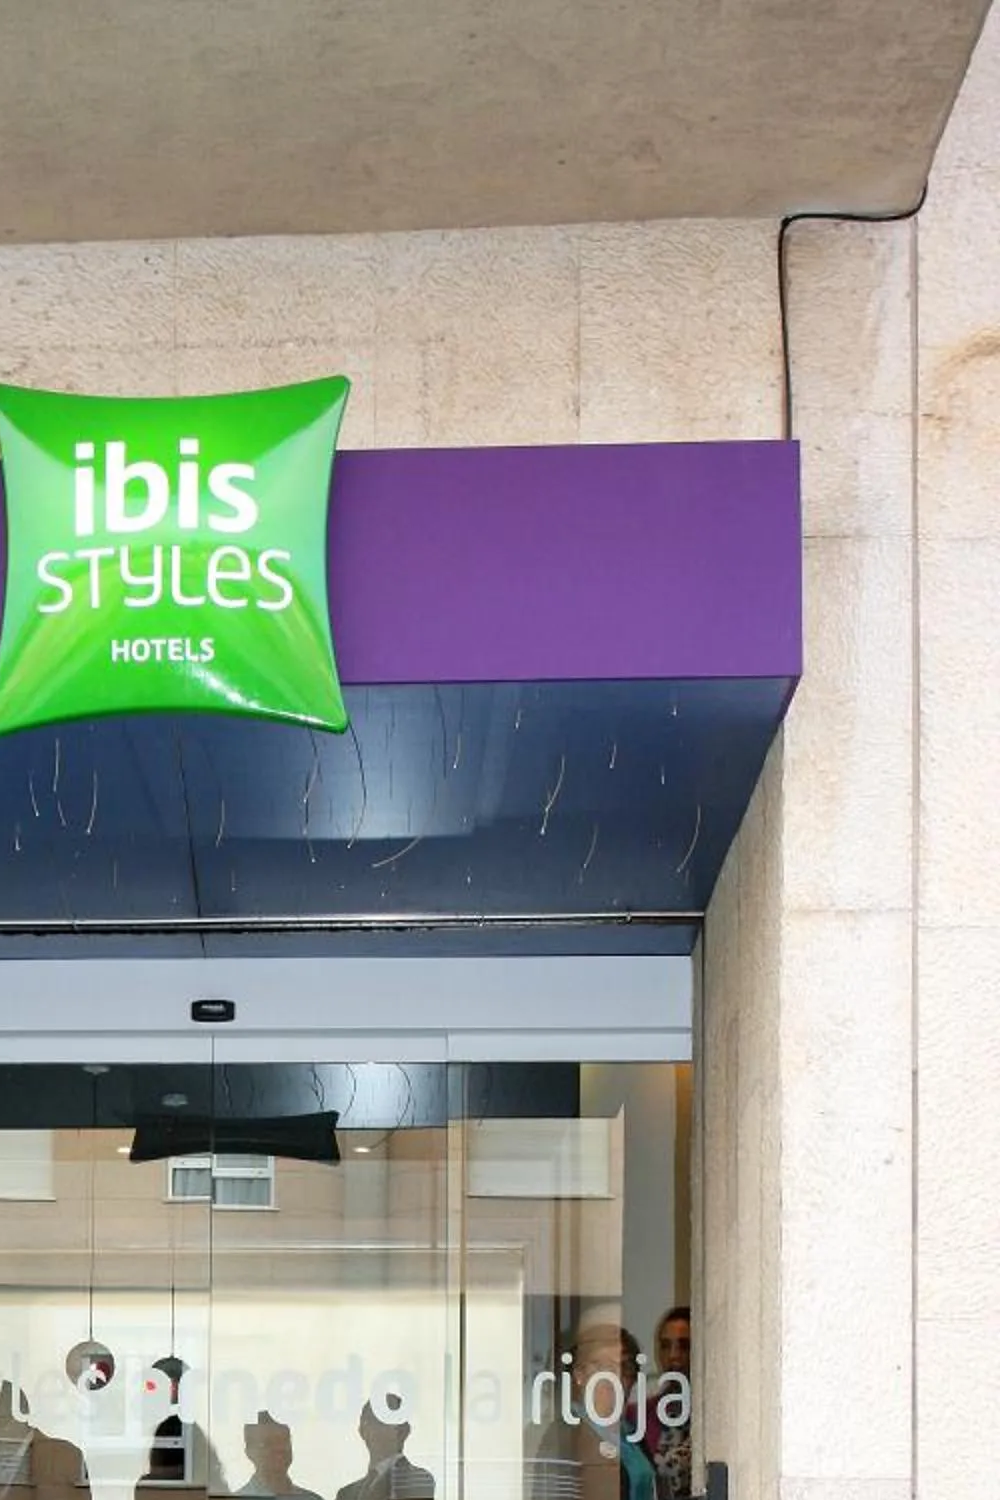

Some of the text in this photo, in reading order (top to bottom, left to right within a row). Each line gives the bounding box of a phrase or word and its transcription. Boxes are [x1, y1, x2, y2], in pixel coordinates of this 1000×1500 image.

[74, 437, 259, 536] ibis
[111, 638, 215, 662] HOTELS
[530, 1352, 692, 1443] rioja
